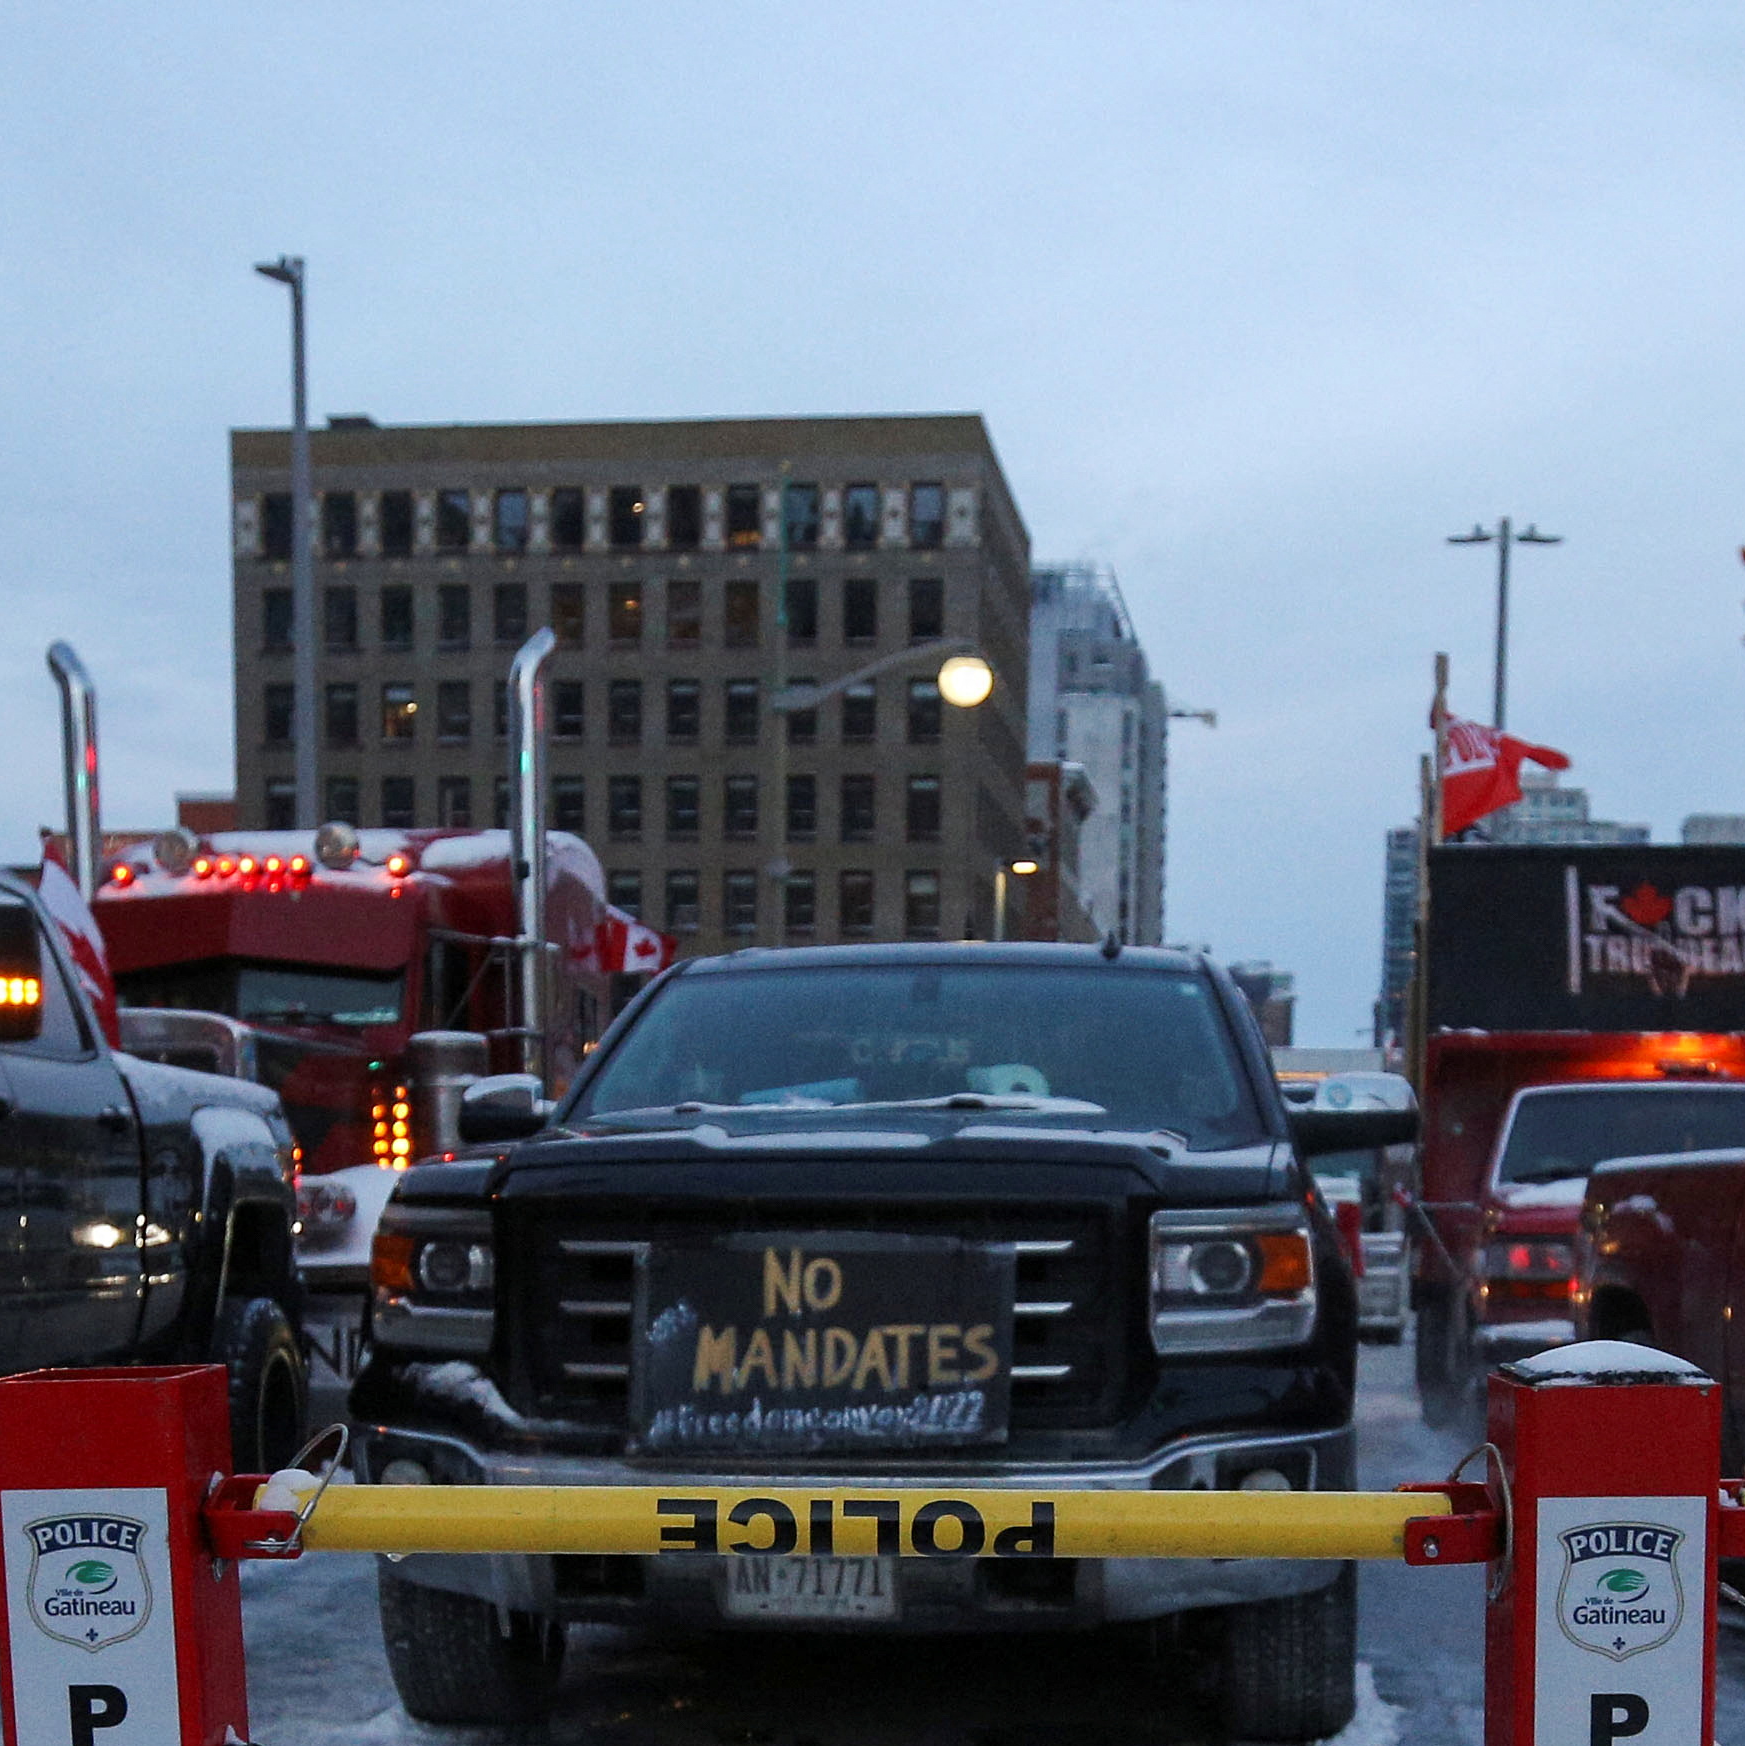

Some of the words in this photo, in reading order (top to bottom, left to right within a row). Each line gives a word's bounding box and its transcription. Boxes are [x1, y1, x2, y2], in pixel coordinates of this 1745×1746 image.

[762, 1246, 843, 1318] NO
[691, 1322, 1000, 1396] MANDATES
[35, 1521, 137, 1550] POLICE
[659, 1498, 1055, 1557] POLICE
[1569, 1529, 1673, 1559] POLICE
[44, 1597, 136, 1616] Gatineau
[1572, 1605, 1665, 1625] Gatineau
